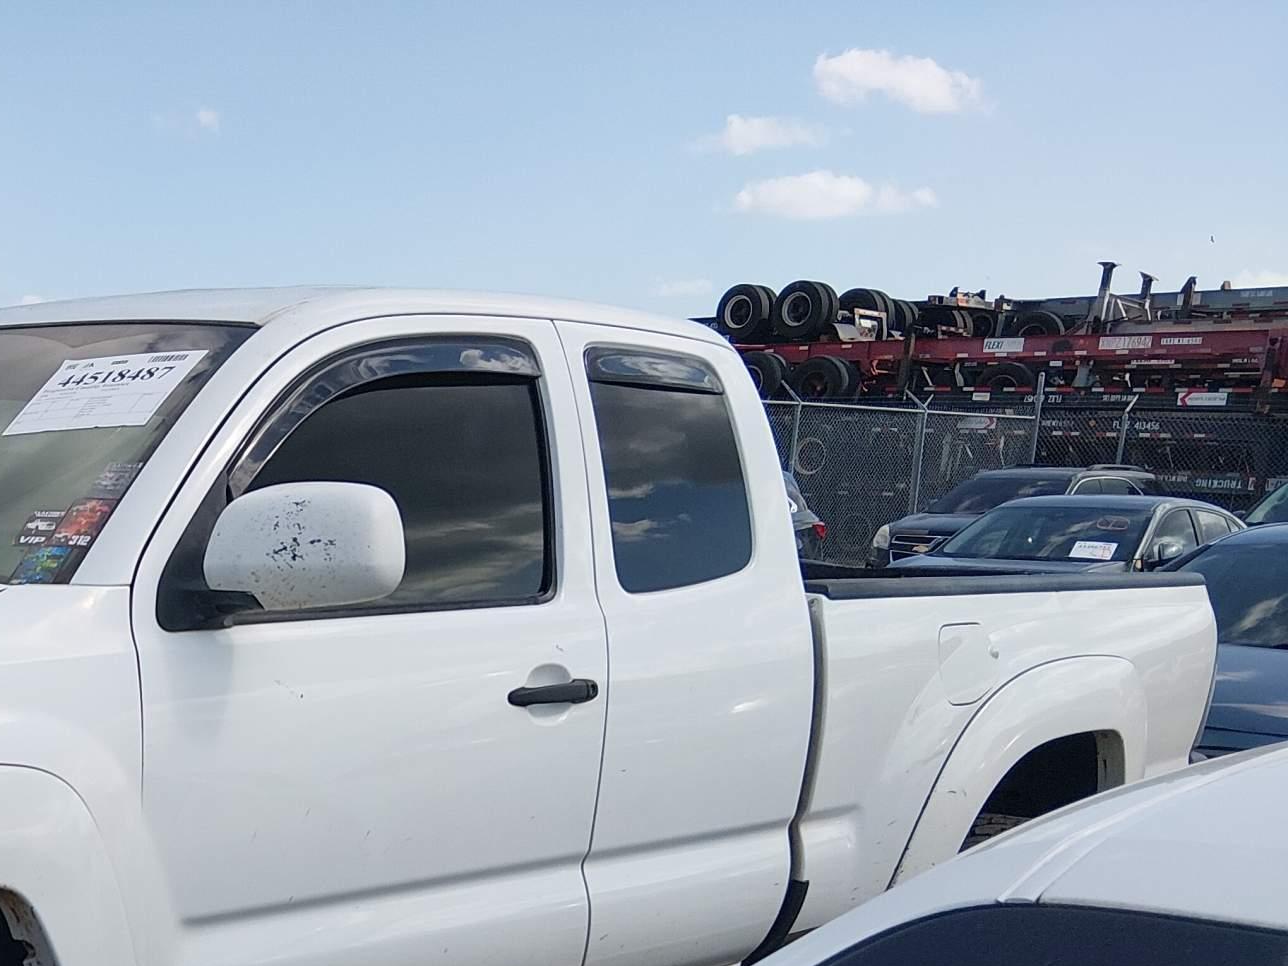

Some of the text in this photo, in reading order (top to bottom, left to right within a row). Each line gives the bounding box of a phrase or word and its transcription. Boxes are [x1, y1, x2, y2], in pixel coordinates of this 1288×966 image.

[58, 366, 176, 387] 44518487
[1134, 421, 1160, 430] 413456
[1195, 478, 1242, 489] TRUCKING
[19, 535, 46, 544] VIP
